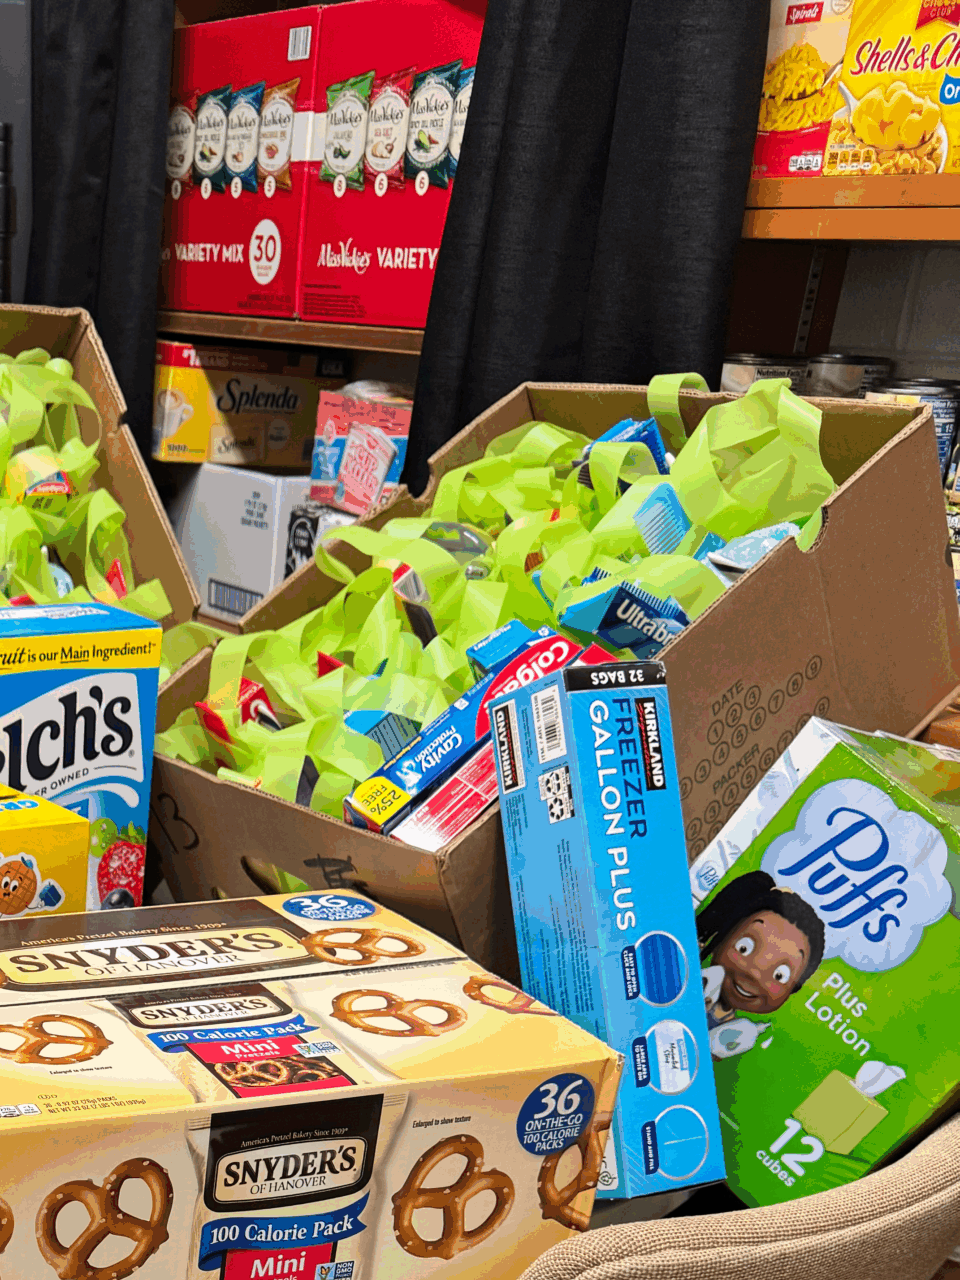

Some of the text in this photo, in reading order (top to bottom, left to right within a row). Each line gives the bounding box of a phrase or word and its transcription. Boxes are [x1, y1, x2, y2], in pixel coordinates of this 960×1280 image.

[790, 7, 819, 20] Spirals
[850, 36, 915, 76] Shells
[174, 243, 244, 263] VARIETY MIX
[253, 235, 276, 262] 30
[376, 246, 439, 270] VARIETY
[756, 369, 786, 378] Nutrition
[217, 378, 299, 414] Splenda
[27, 651, 37, 663] is
[38, 652, 58, 663] our
[60, 647, 90, 663] Main
[92, 643, 153, 662] Ingredient!
[590, 668, 645, 686] 32 BAGS
[711, 679, 745, 716] DATE
[415, 725, 457, 762] Protection
[421, 733, 463, 772] Cavity
[496, 710, 514, 787] KIRKLAND
[643, 701, 665, 787] KIRKLAND
[49, 767, 90, 791] OWNED
[612, 698, 648, 840] FREEZER
[713, 743, 760, 795] PACKER
[362, 784, 388, 807] FREE
[370, 789, 402, 816] 25%
[590, 699, 637, 931] GALLON PLUS
[778, 806, 909, 943] Puffs
[290, 894, 349, 911] 36
[21, 935, 76, 946] America's
[78, 931, 117, 943] Pretzel
[119, 927, 158, 938] Bakery
[9, 932, 284, 974] SNYDER'S
[85, 953, 245, 977] OF HANOVER
[822, 972, 868, 1018] Plus
[140, 998, 268, 1021] SNYDER'S
[158, 1022, 305, 1043] 100 Calorie Pack
[804, 991, 871, 1056] Lotion
[220, 1039, 281, 1055] Mini
[234, 1049, 281, 1059] Pretzels
[533, 1079, 584, 1120] 36
[412, 1118, 434, 1129] Enlarged
[440, 1117, 454, 1126] show
[454, 1116, 472, 1124] texture
[525, 1113, 583, 1132] ON-THE-GO
[241, 1129, 329, 1148] America's Pretzel Bakery Since
[523, 1126, 580, 1145] 100 CALORIE
[534, 1138, 564, 1152] PACKS
[769, 1117, 824, 1177] 12
[223, 1145, 357, 1188] SNYDER'S
[756, 1149, 796, 1187] cubes
[250, 1175, 326, 1195] OF HANOVER
[210, 1214, 355, 1245] 100 Calorie Pack
[250, 1251, 307, 1279] Mini
[337, 1262, 353, 1270] NON
